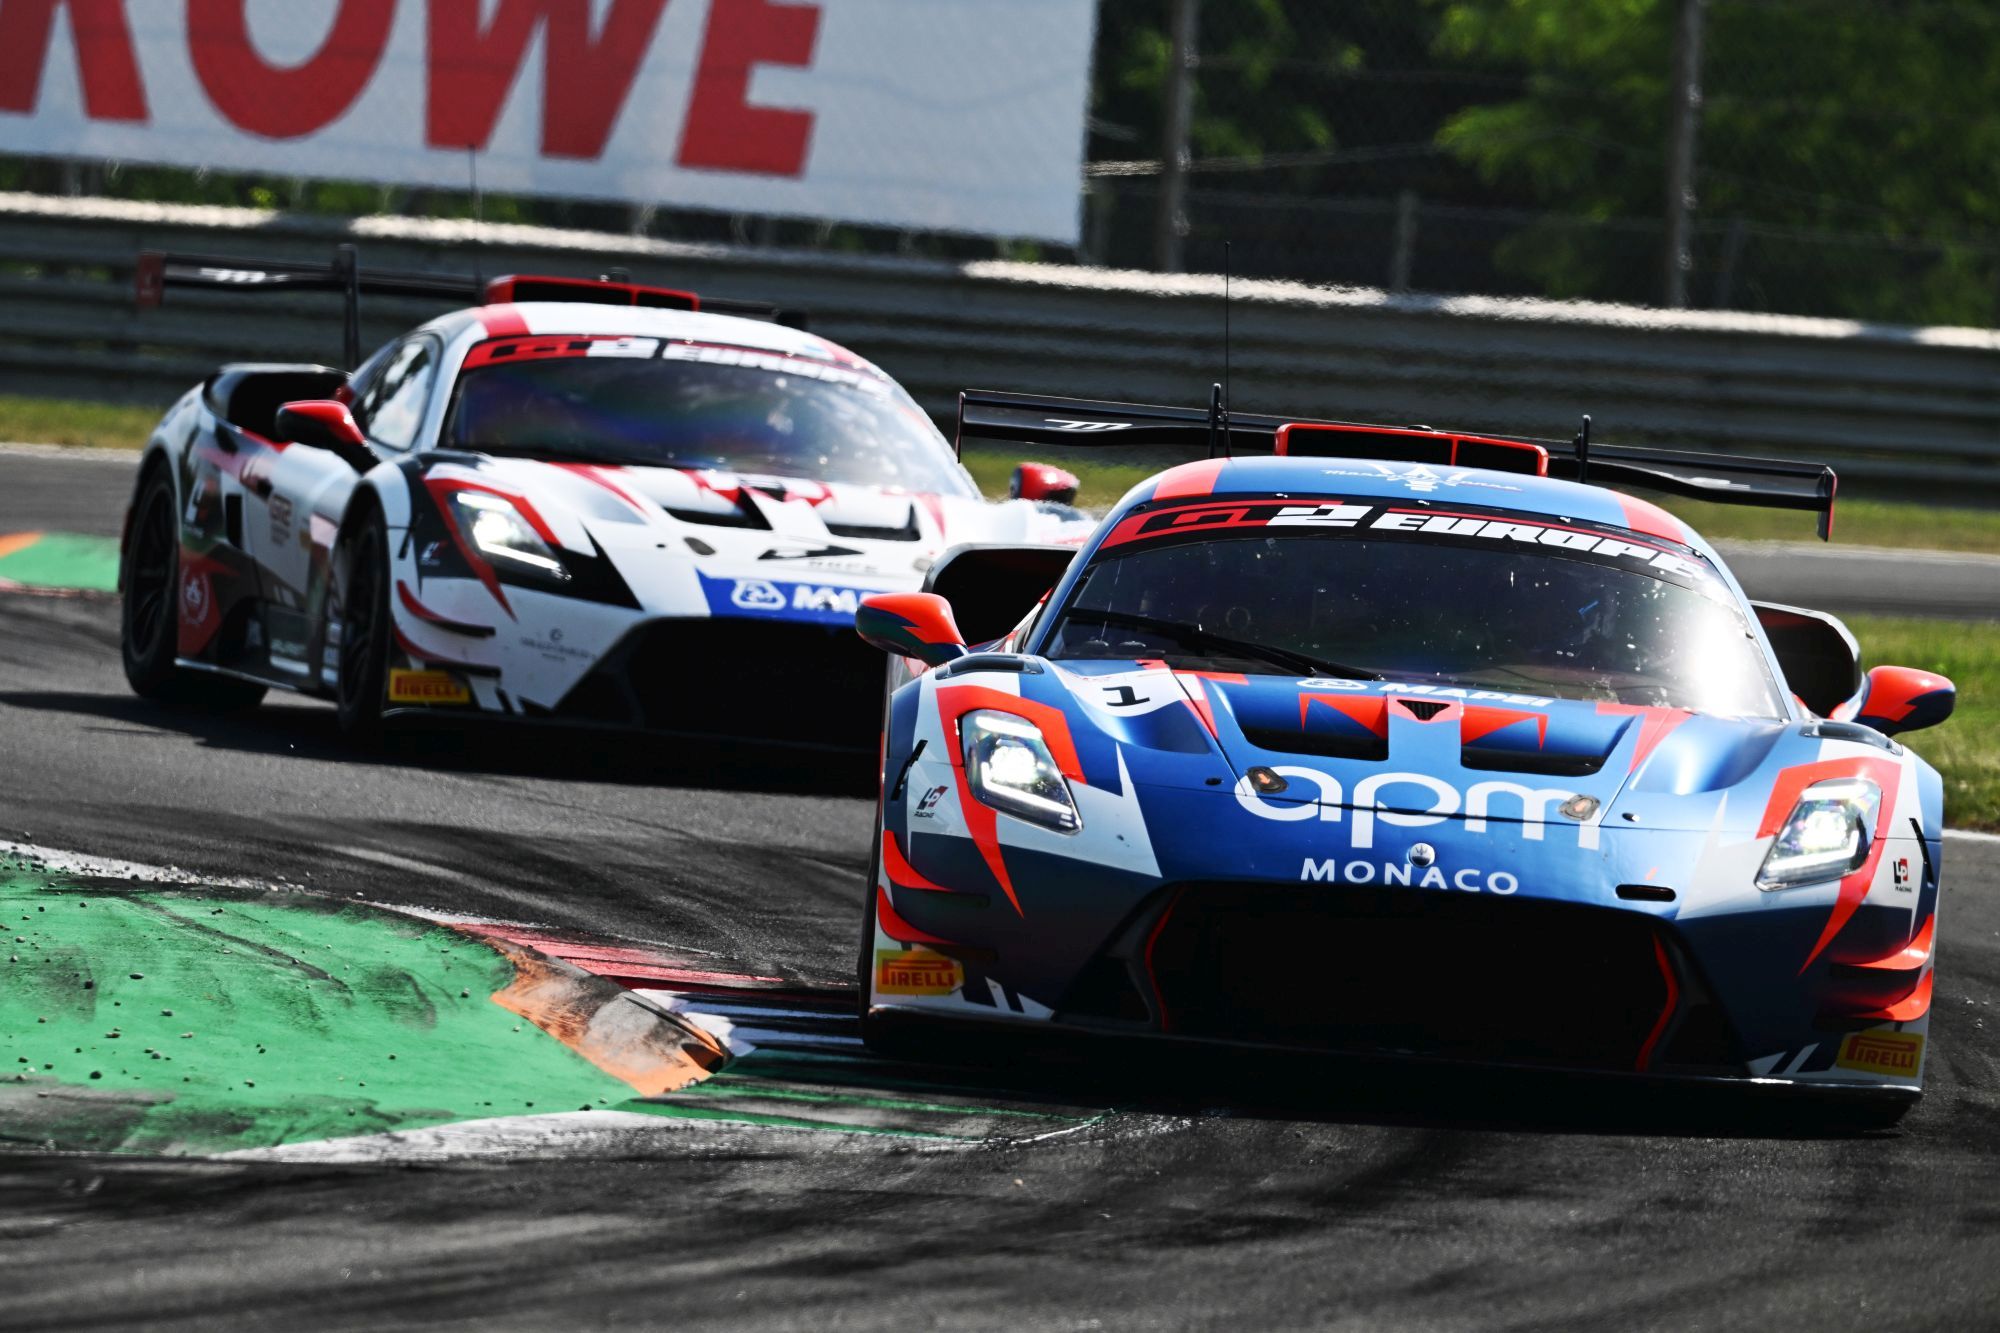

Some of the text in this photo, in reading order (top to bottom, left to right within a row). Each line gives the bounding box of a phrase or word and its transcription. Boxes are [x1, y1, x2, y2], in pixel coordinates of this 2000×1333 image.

[1370, 512, 1708, 578] EUROPE
[394, 675, 462, 697] PIRELLI
[1379, 682, 1555, 708] MAPEI
[1235, 766, 1600, 850] apm
[1300, 857, 1519, 895] MONACO
[882, 959, 955, 987] PIRELLI
[1845, 1035, 1918, 1069] PIRELLI
